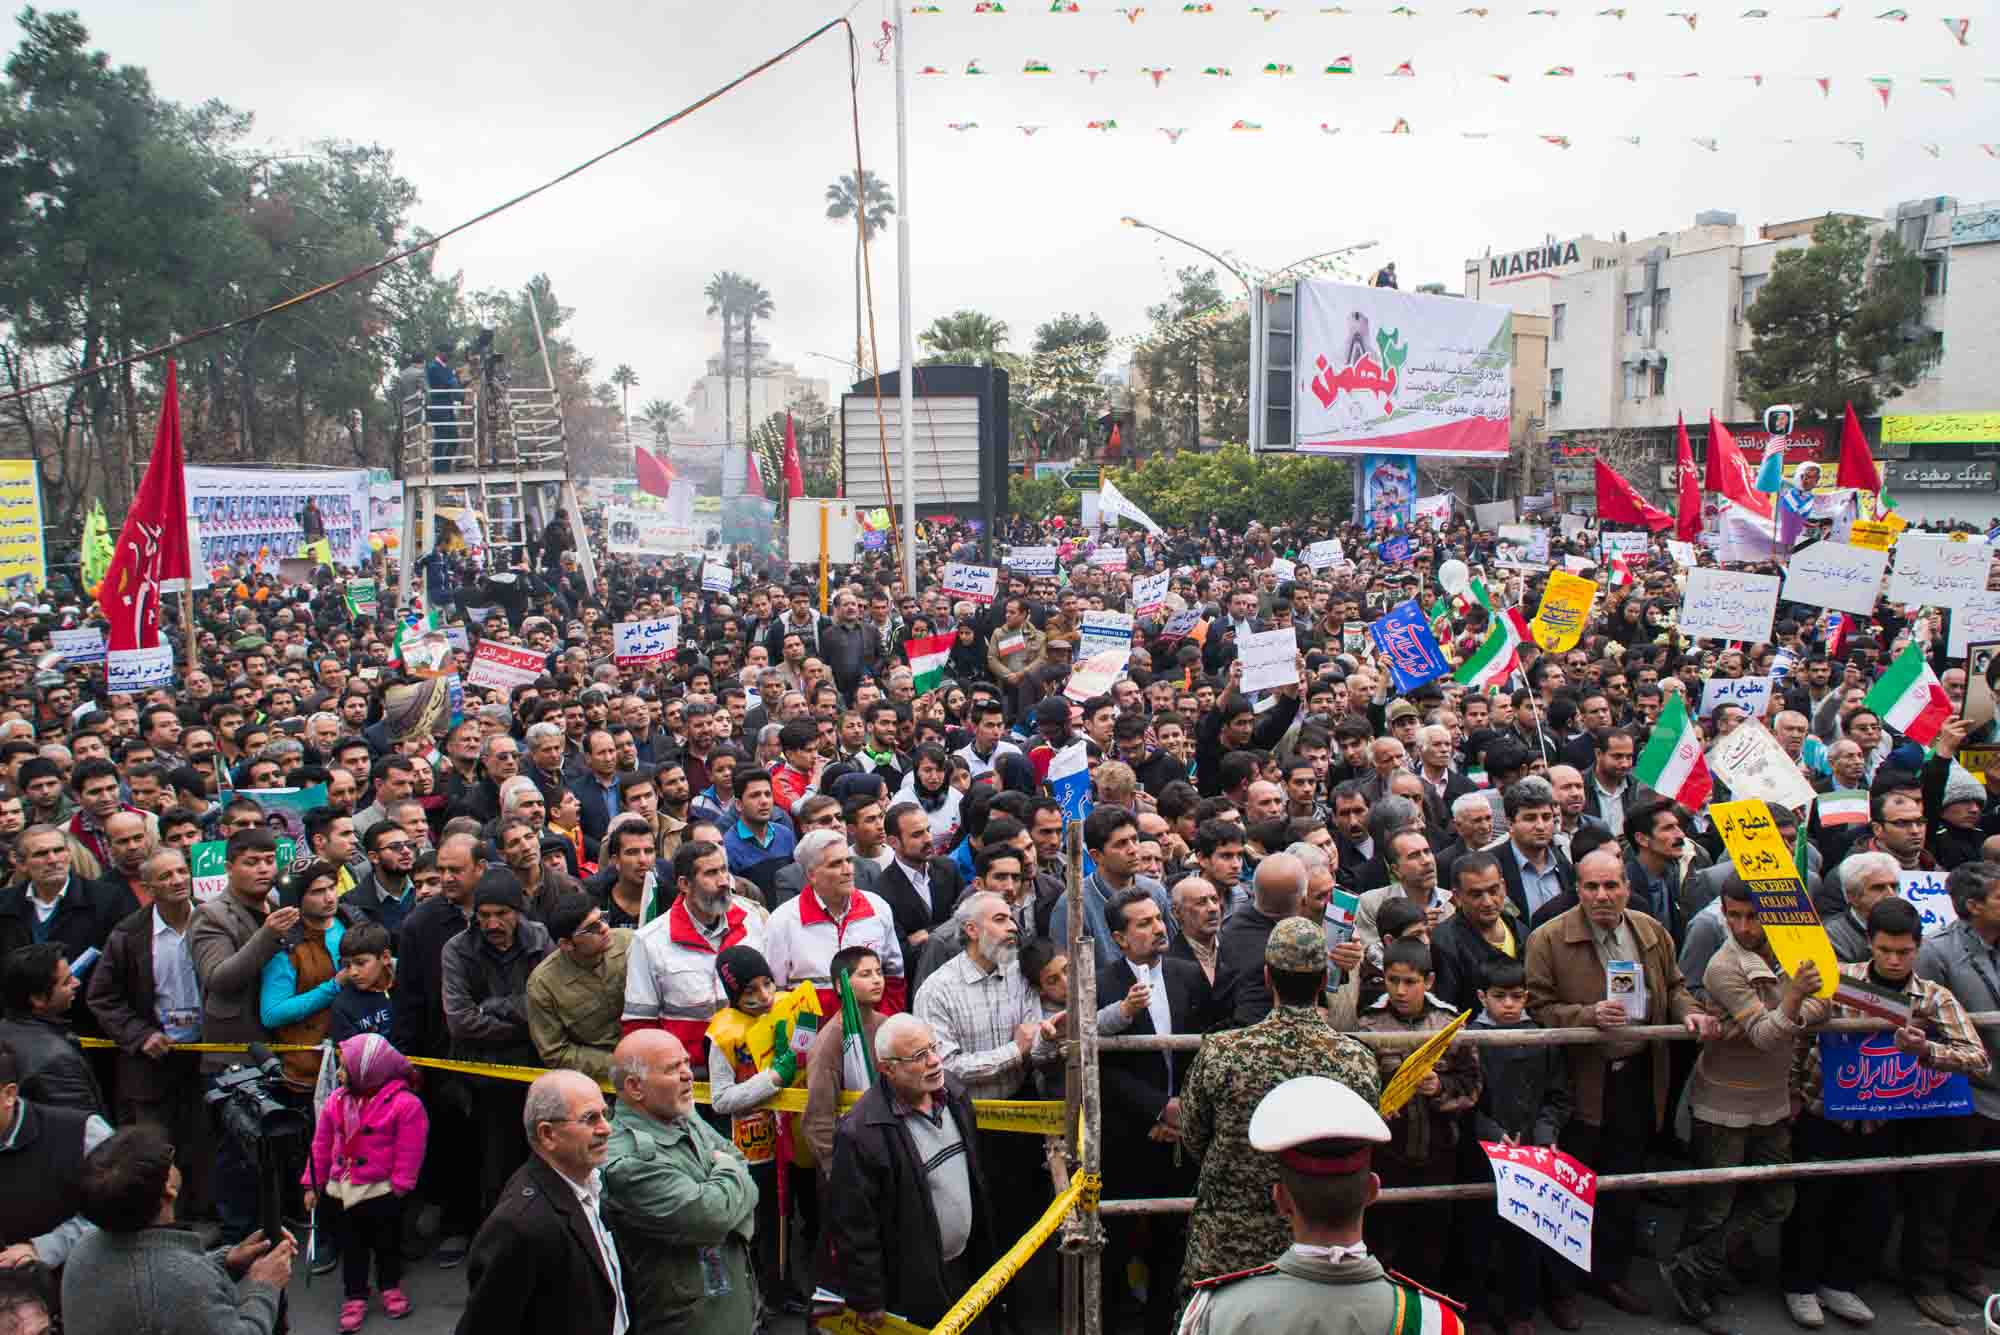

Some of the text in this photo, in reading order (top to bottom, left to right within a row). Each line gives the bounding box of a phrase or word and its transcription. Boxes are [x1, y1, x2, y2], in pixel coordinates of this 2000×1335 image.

[1490, 242, 1580, 278] MARINA
[1311, 352, 1396, 417] بهمن
[1903, 463, 1993, 484] عینک مهدی
[624, 621, 670, 640] مطیع امر
[630, 640, 664, 653] رهبریم
[522, 656, 542, 670] مرگ
[1714, 681, 1763, 698] مطیع امر
[1723, 808, 1769, 840] مطیع امر
[1749, 879, 1797, 893] SINCERELY
[1760, 895, 1799, 908] FOLLOW
[1759, 912, 1816, 923] OUR LEADER
